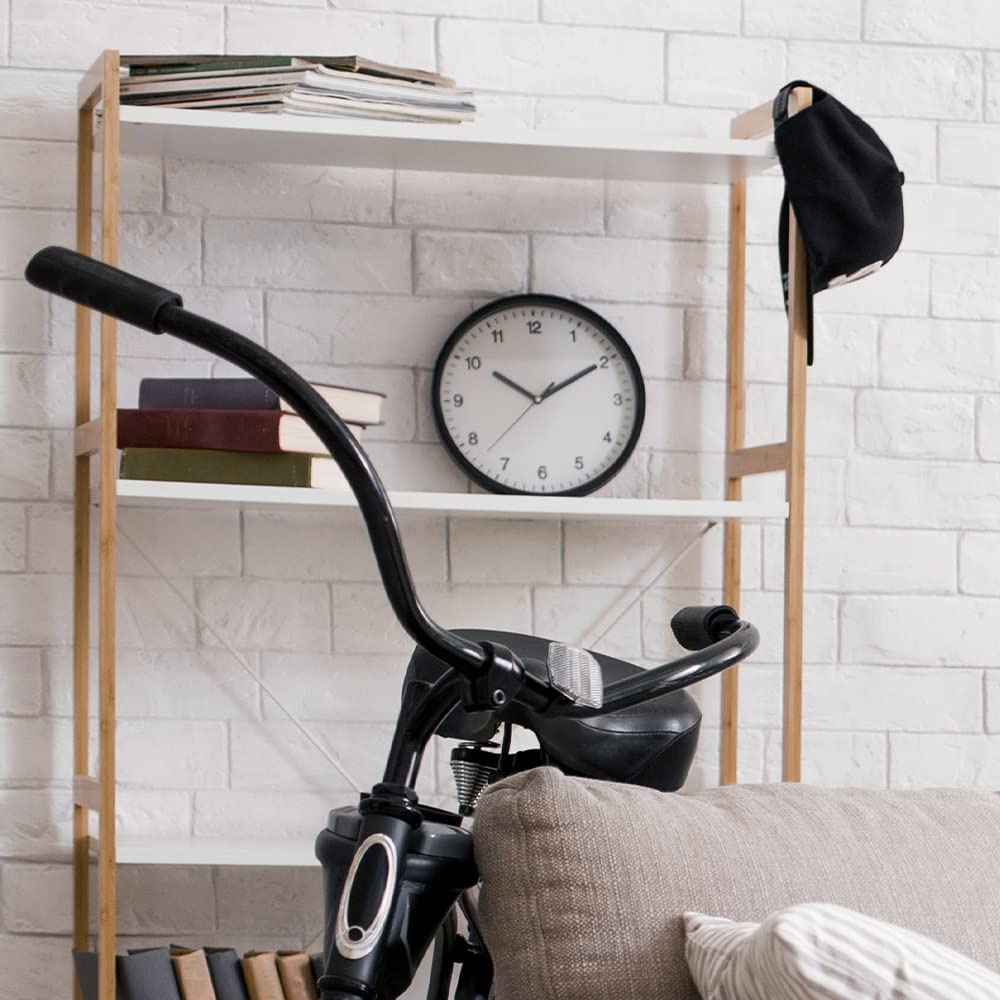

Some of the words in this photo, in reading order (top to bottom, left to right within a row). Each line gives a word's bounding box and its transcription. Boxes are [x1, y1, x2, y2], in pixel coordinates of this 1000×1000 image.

[526, 320, 542, 335] 12
[491, 329, 504, 344] 11
[569, 330, 577, 343] 1
[465, 355, 482, 371] 10
[599, 356, 609, 369] 2
[453, 393, 464, 408] 9
[612, 393, 623, 407] 3
[468, 431, 479, 446] 8
[602, 431, 613, 444] 4
[499, 456, 510, 471] 7
[574, 456, 584, 470] 5
[537, 466, 548, 480] 6
